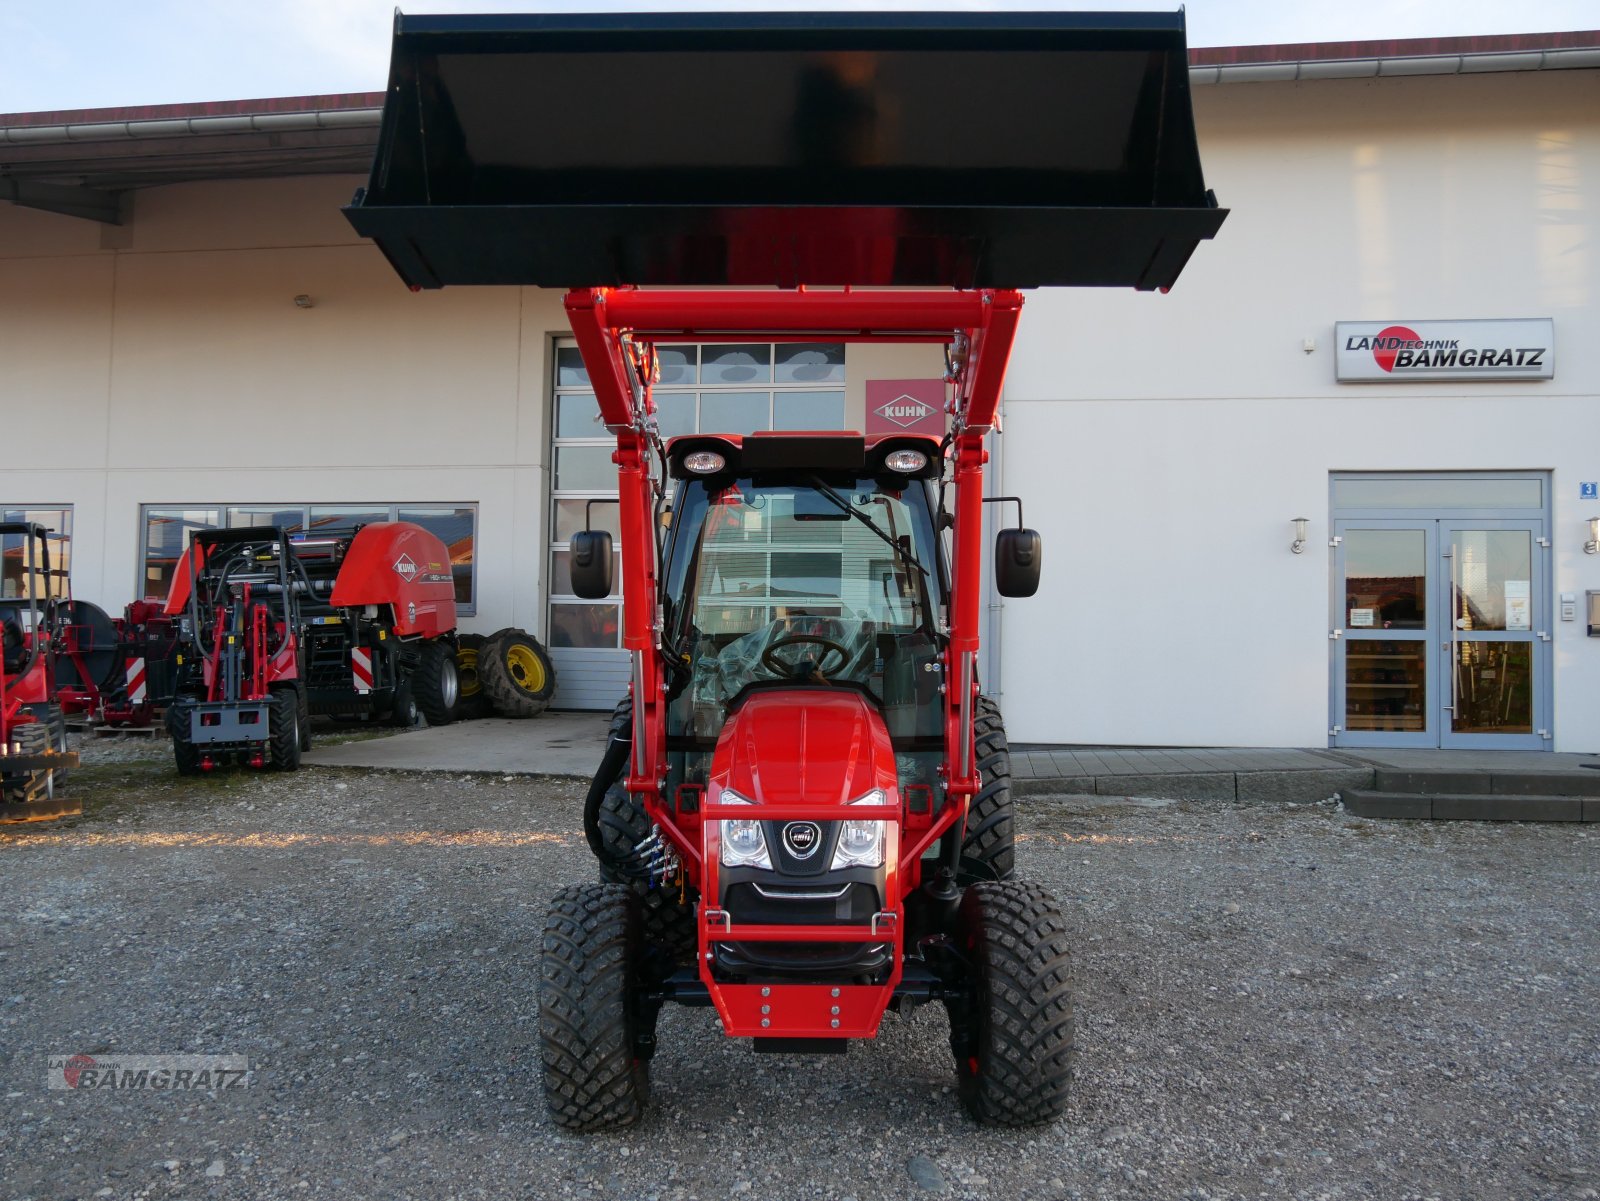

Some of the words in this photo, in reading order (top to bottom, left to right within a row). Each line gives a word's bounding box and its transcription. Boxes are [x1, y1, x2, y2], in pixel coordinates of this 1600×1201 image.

[1395, 348, 1546, 368] BAMGRATZ
[885, 406, 926, 417] KUHN
[1586, 484, 1592, 494] 3
[397, 563, 416, 573] KUHN
